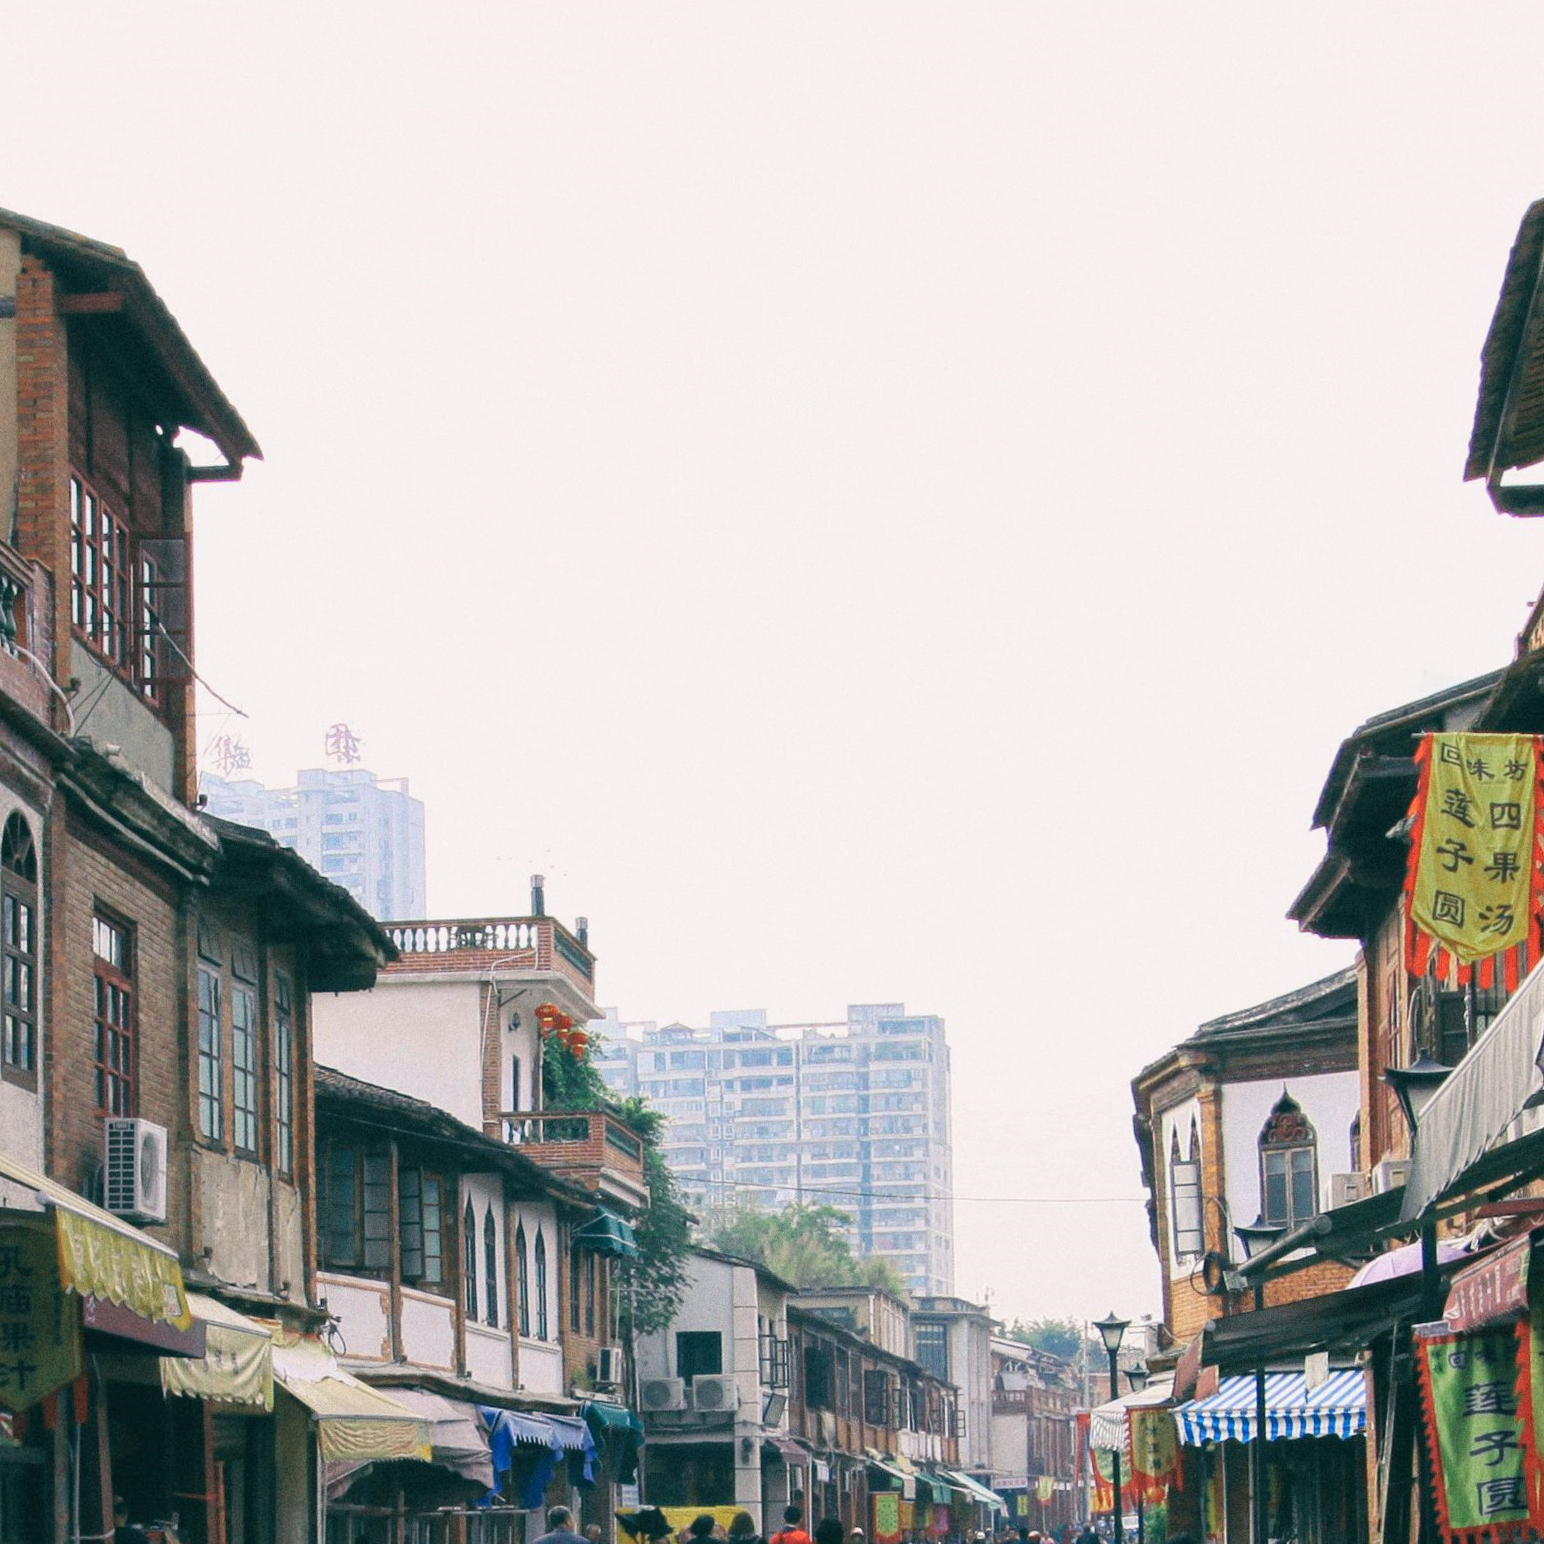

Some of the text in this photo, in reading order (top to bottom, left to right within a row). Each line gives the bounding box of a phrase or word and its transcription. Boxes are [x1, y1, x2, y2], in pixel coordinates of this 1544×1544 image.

[1441, 742, 1527, 781] 回味坊
[1432, 788, 1476, 928] 莲子圆
[1478, 802, 1522, 936] 四果汤
